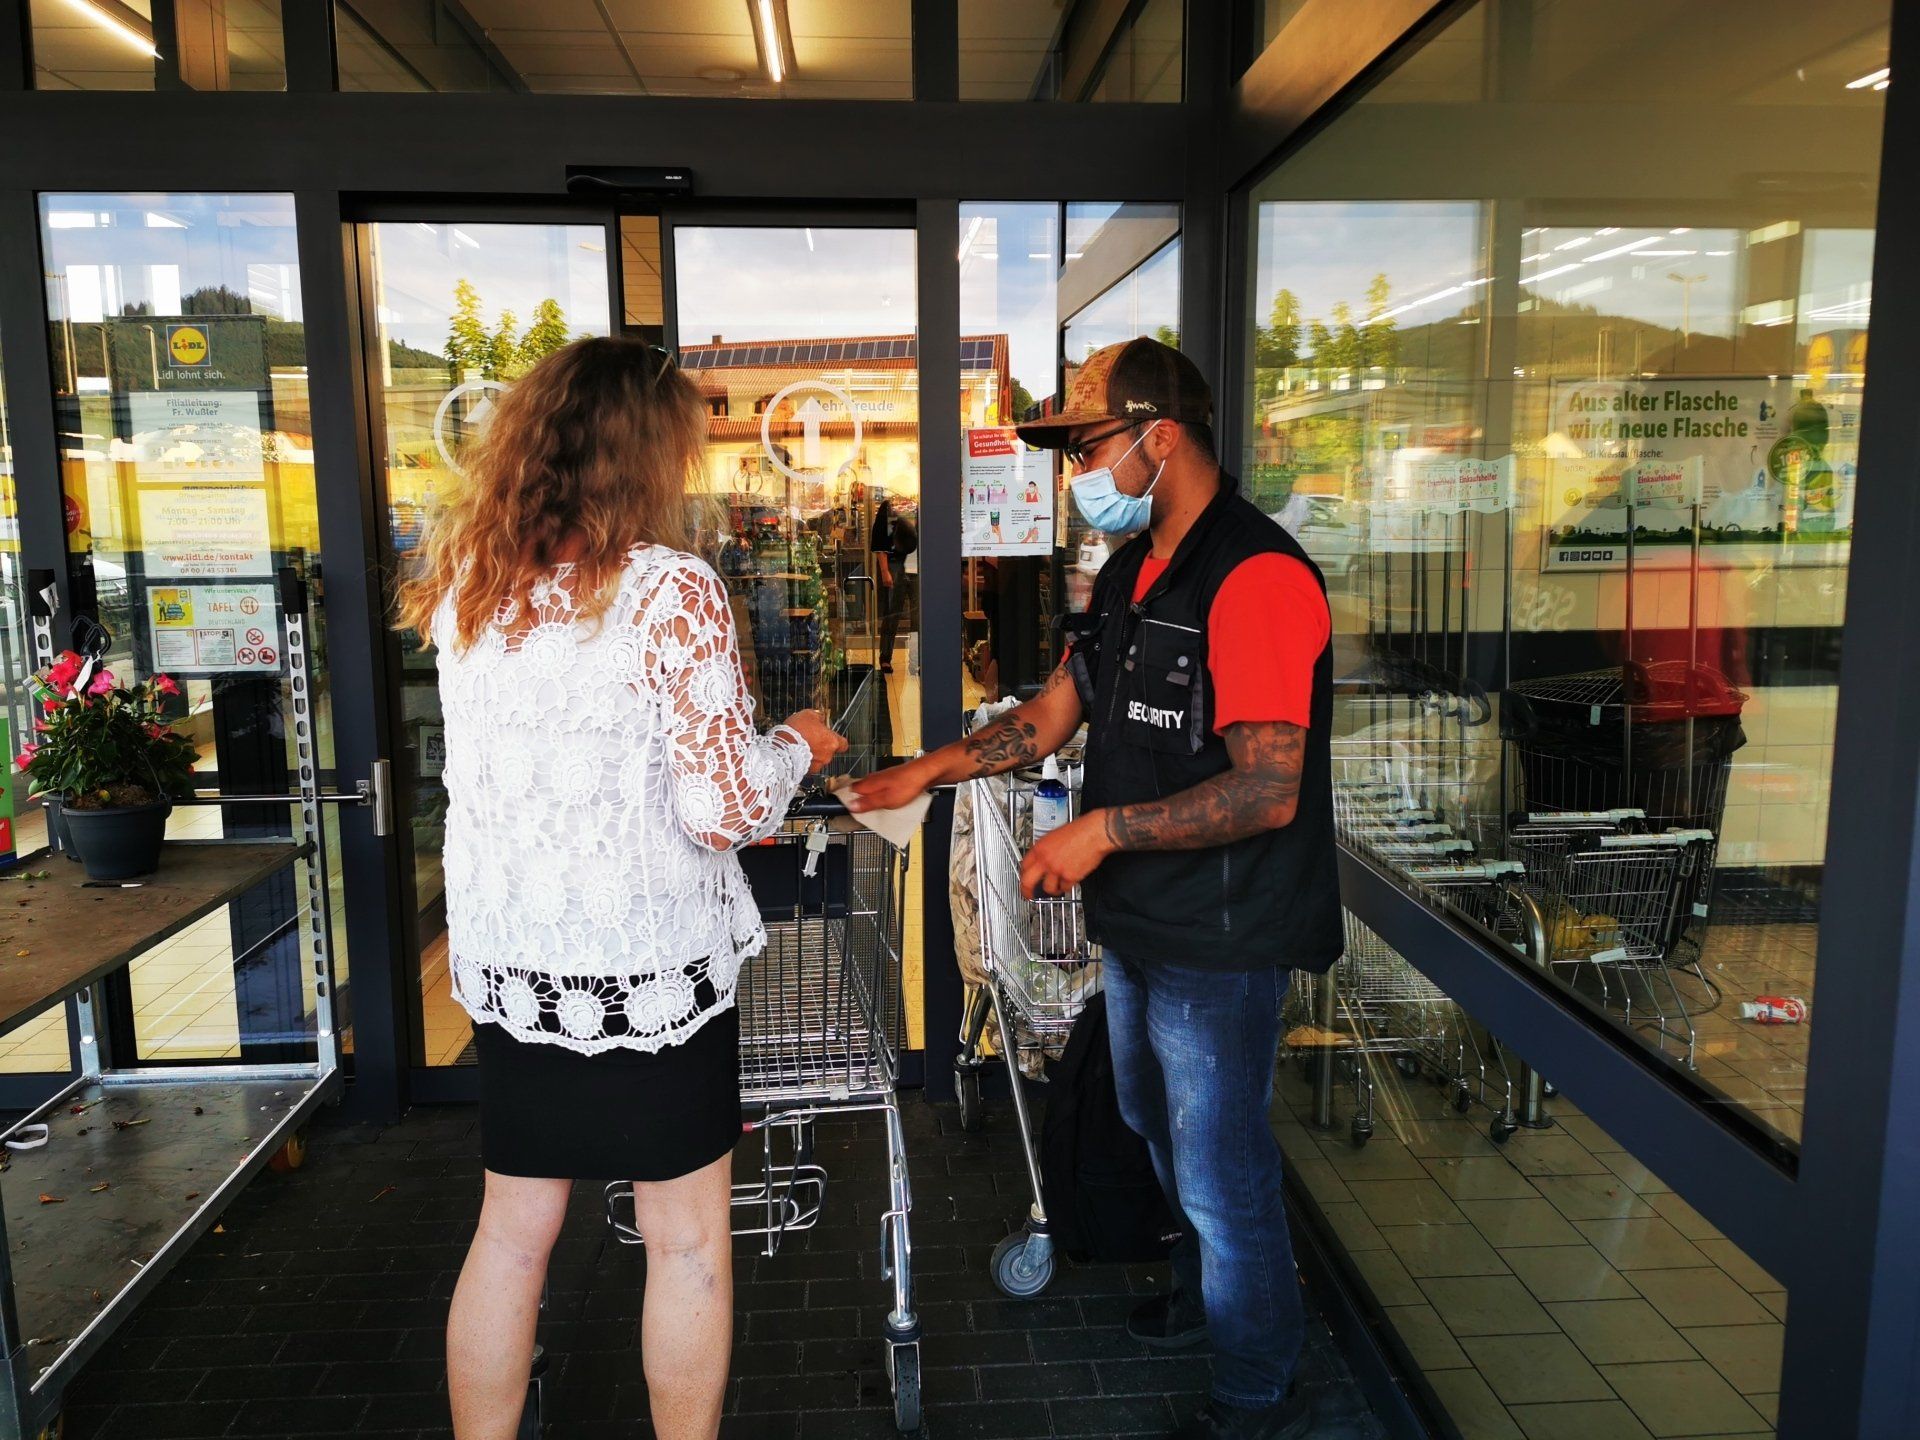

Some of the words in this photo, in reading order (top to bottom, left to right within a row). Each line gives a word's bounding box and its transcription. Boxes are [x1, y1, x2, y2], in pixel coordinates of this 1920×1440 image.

[173, 338, 205, 351] LIDL
[157, 370, 174, 380] Lidl
[177, 370, 201, 380] lohnt
[203, 370, 226, 379] sich.
[817, 400, 844, 411] ehr
[852, 400, 894, 411] reude
[1569, 391, 1608, 412] Aus
[1612, 390, 1658, 412] alter
[1663, 390, 1739, 412] Flasche
[172, 408, 184, 416] Fr.
[1568, 417, 1613, 439] wird
[1618, 421, 1668, 439] neue
[1673, 416, 1749, 439] Flasche
[1637, 473, 1683, 484] Einkaufshelfer
[162, 552, 254, 562] www.lidl.de/kontakt
[207, 602, 235, 612] TAFEL
[1127, 700, 1184, 729] SECURITY
[1161, 1232, 1182, 1241] EASTPA
